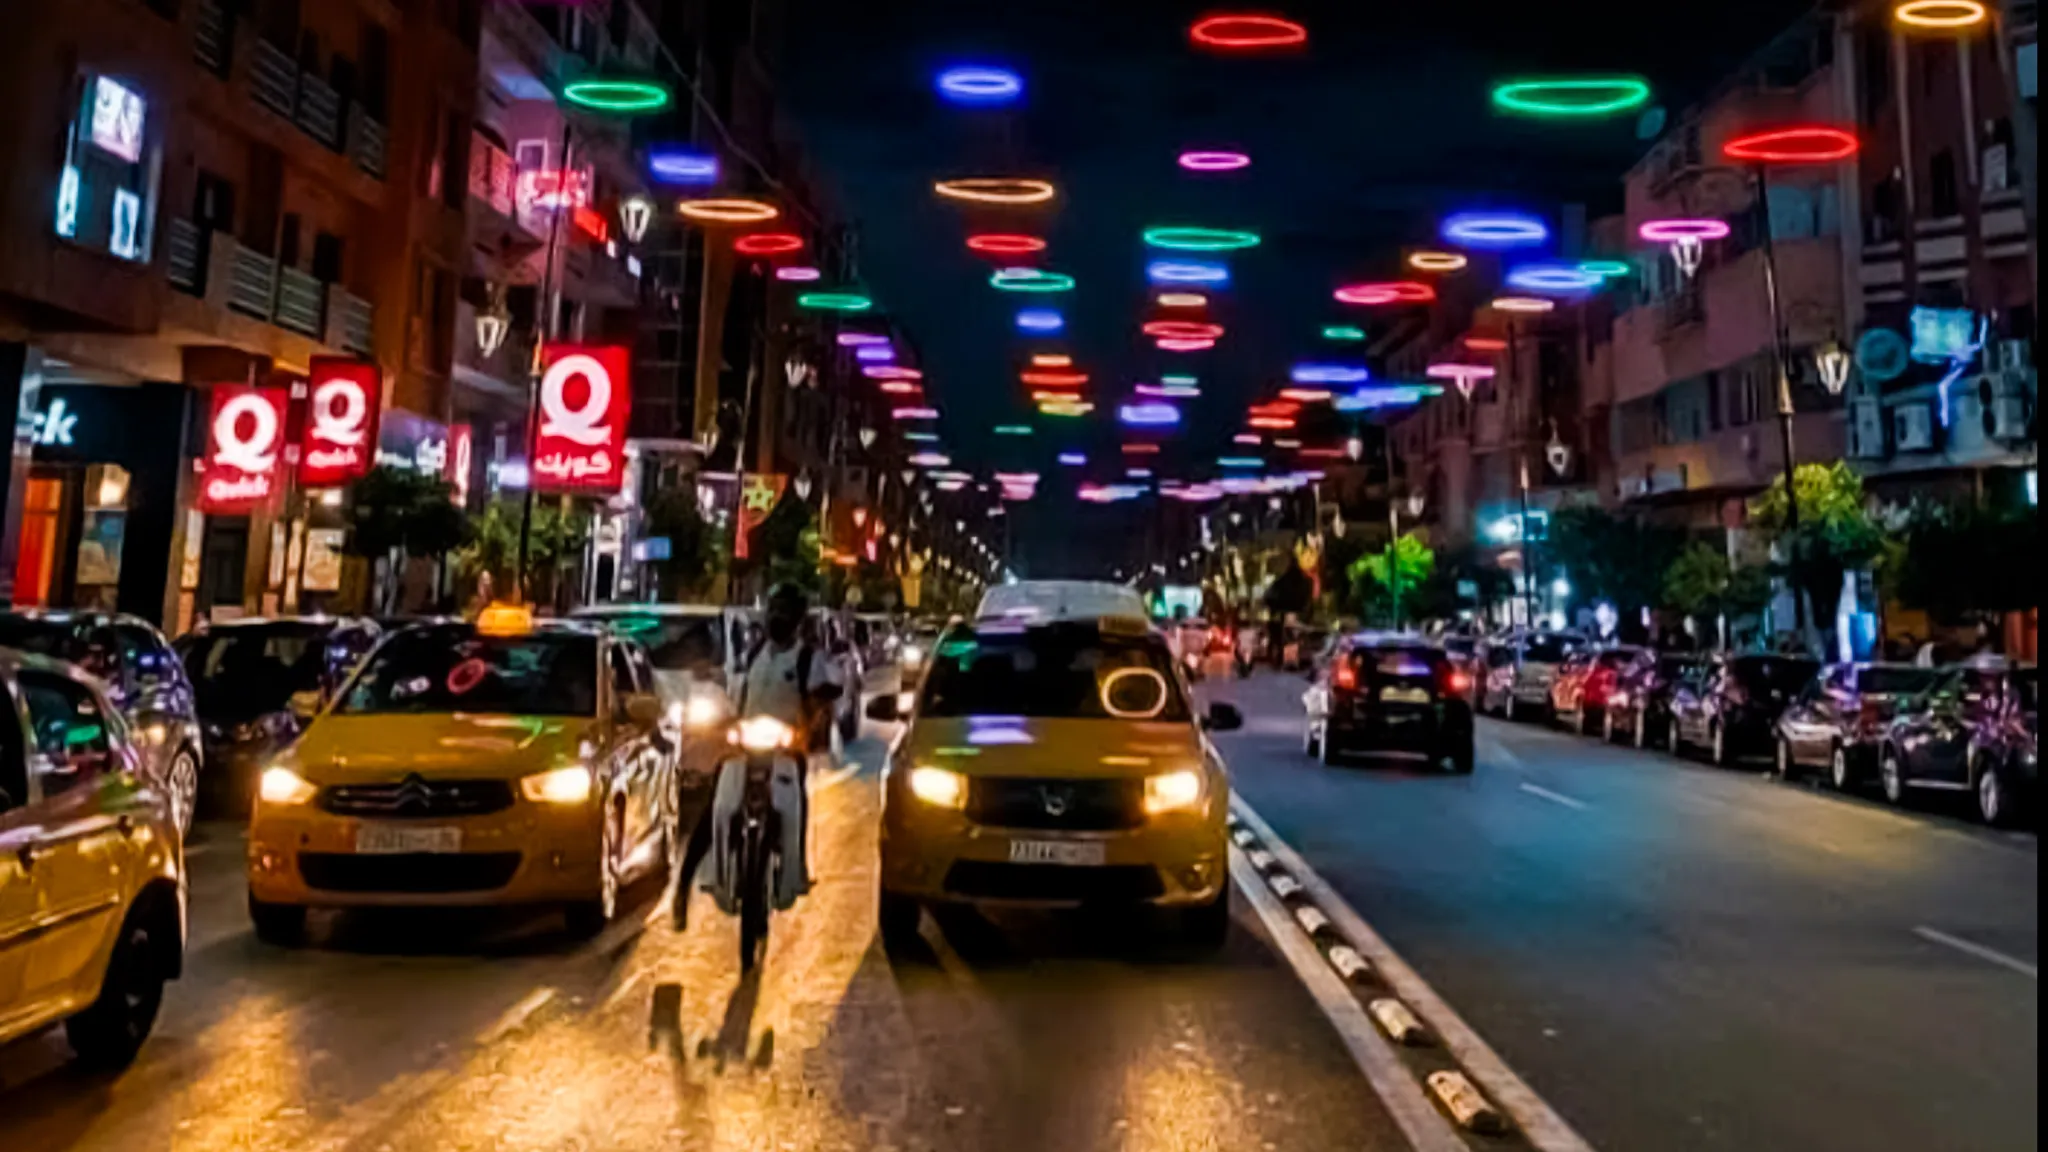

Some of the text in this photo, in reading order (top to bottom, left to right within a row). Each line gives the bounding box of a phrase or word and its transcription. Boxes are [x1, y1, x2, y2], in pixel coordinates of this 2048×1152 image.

[213, 394, 277, 472] Q
[312, 379, 365, 445] Q
[541, 354, 611, 446] Q
